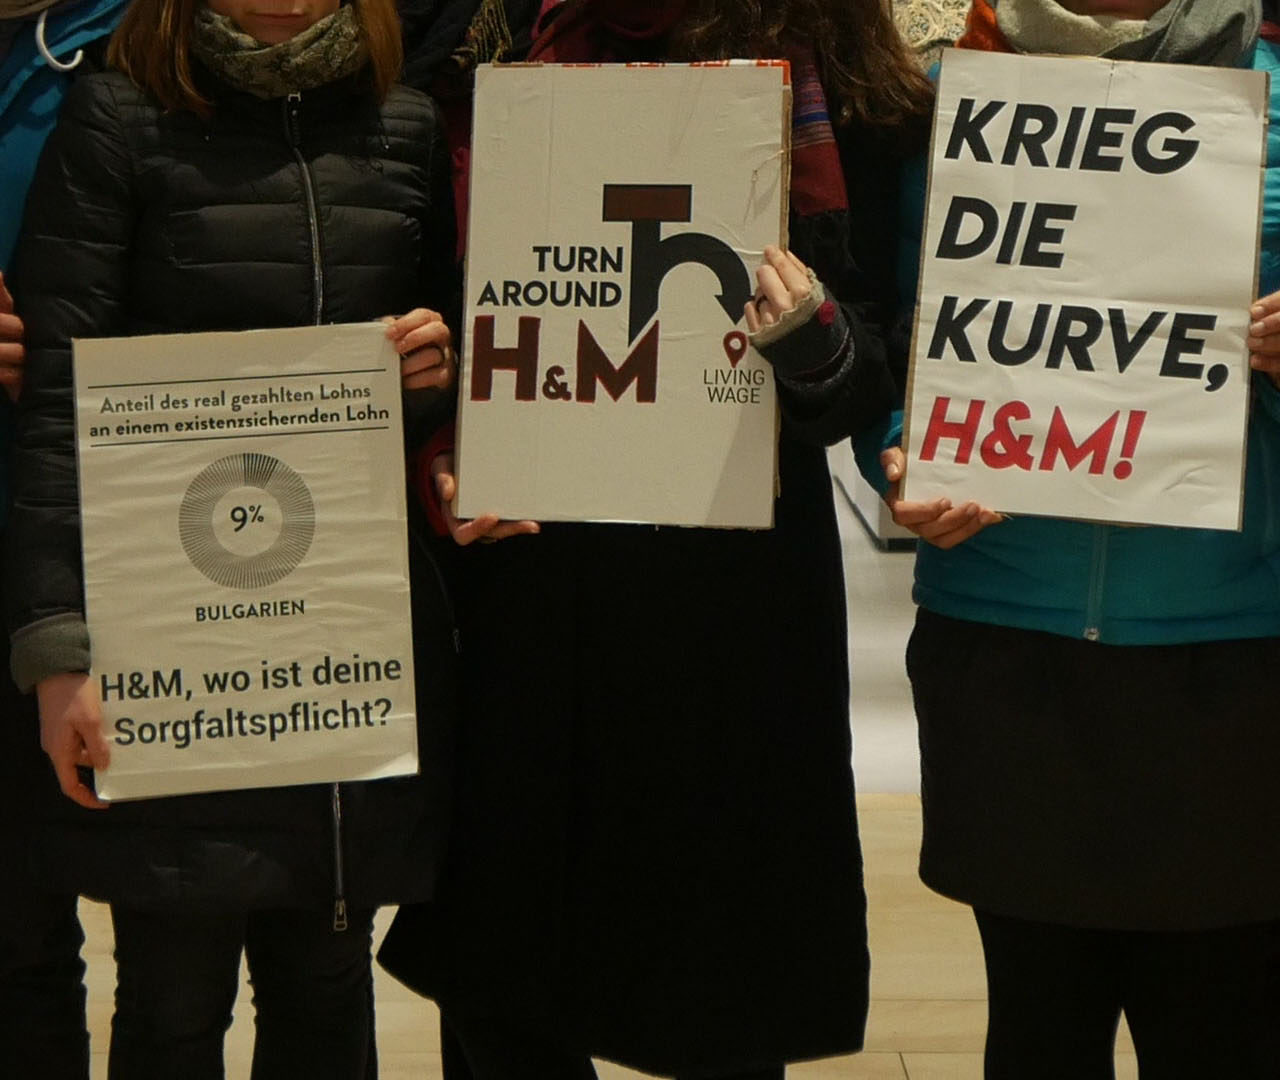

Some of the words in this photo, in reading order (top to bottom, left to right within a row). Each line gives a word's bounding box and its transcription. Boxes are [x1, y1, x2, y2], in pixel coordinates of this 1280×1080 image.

[944, 97, 1200, 175] KRIEG
[935, 195, 1078, 268] DIE
[533, 245, 623, 273] TURN
[477, 280, 622, 307] AROUND
[470, 315, 659, 403] H&M
[927, 296, 1229, 392] KURVE,
[703, 368, 765, 386] LIVING
[100, 395, 154, 414] Anteil
[160, 392, 188, 410] des
[194, 390, 226, 408] real
[231, 387, 314, 417] gezahlten
[320, 382, 371, 401] Lohns
[707, 387, 760, 404] WAGE
[90, 424, 110, 437] an
[116, 419, 169, 436] einem
[175, 409, 341, 432] existenzsichernden
[346, 404, 389, 422] Lohn
[918, 396, 1147, 480] H&M!
[230, 505, 264, 532] 9%
[195, 599, 305, 622] BULGARIEN
[101, 669, 192, 702] H&M,
[204, 671, 250, 693] wo
[262, 660, 301, 690] ist
[313, 654, 402, 687] deine
[114, 698, 392, 749] Sorgfaltspflicht?
